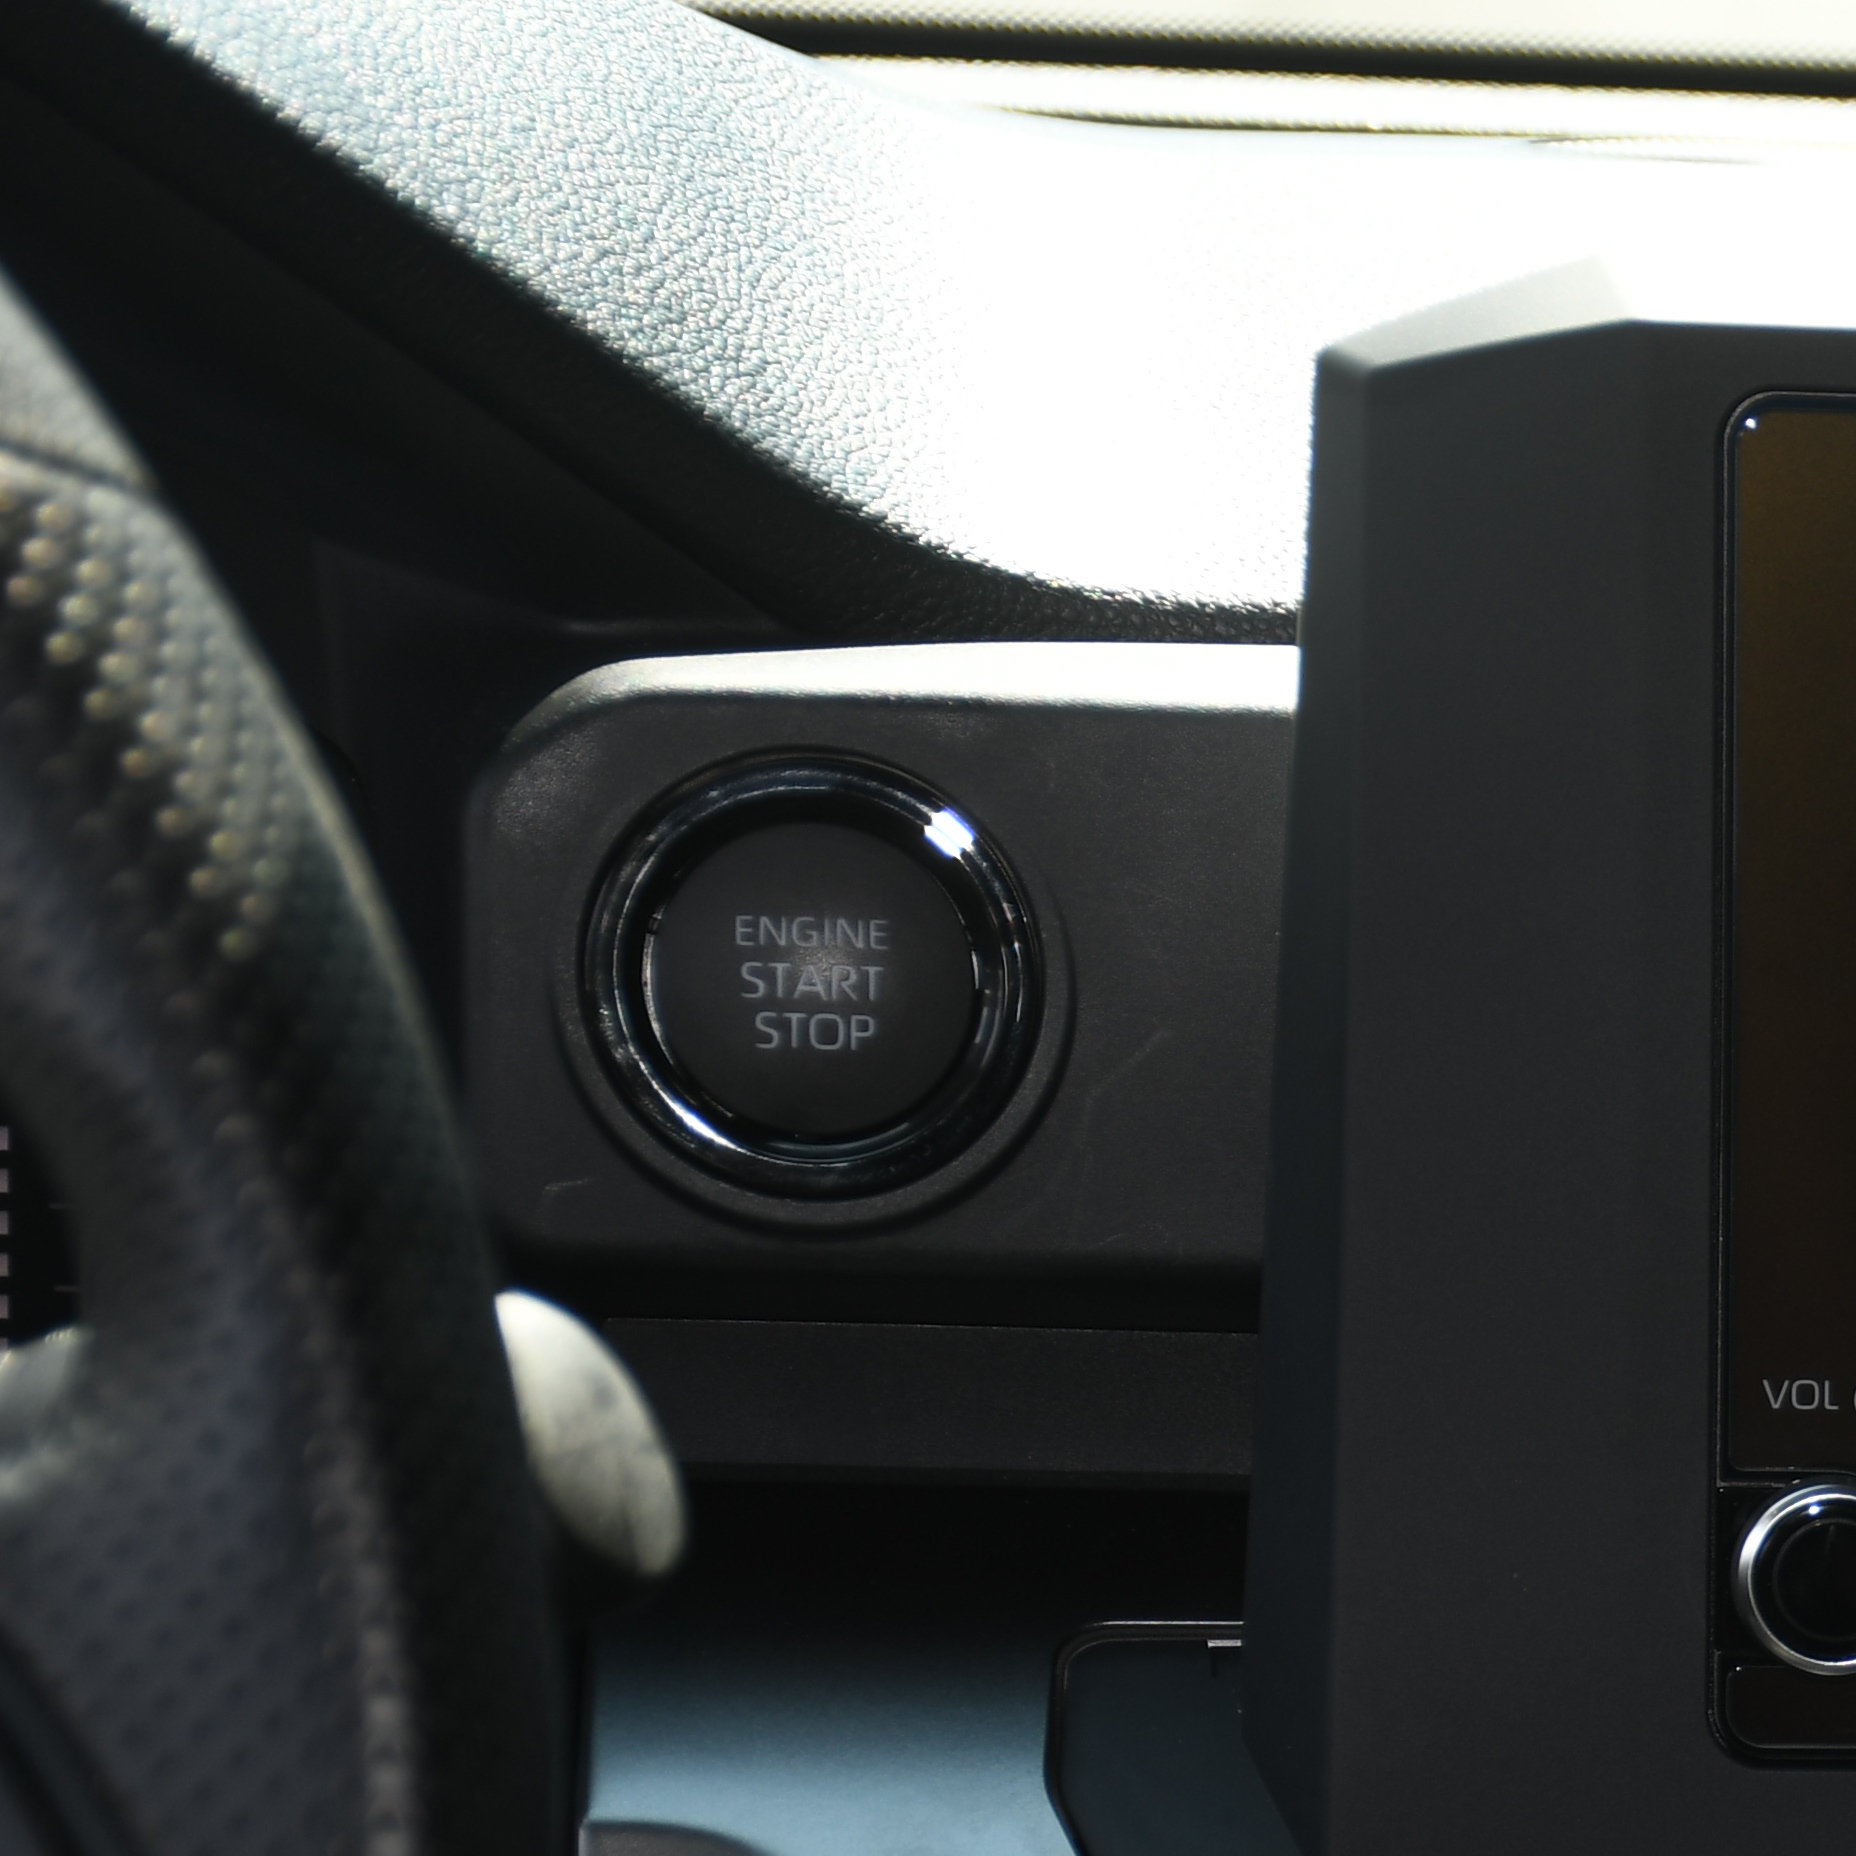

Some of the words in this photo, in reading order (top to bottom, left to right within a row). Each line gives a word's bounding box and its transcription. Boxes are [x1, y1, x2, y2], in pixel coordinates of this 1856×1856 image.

[735, 915, 889, 950] ENGINE
[740, 961, 884, 1001] START
[755, 1011, 876, 1051] STOP
[1762, 1379, 1839, 1410] VOL
